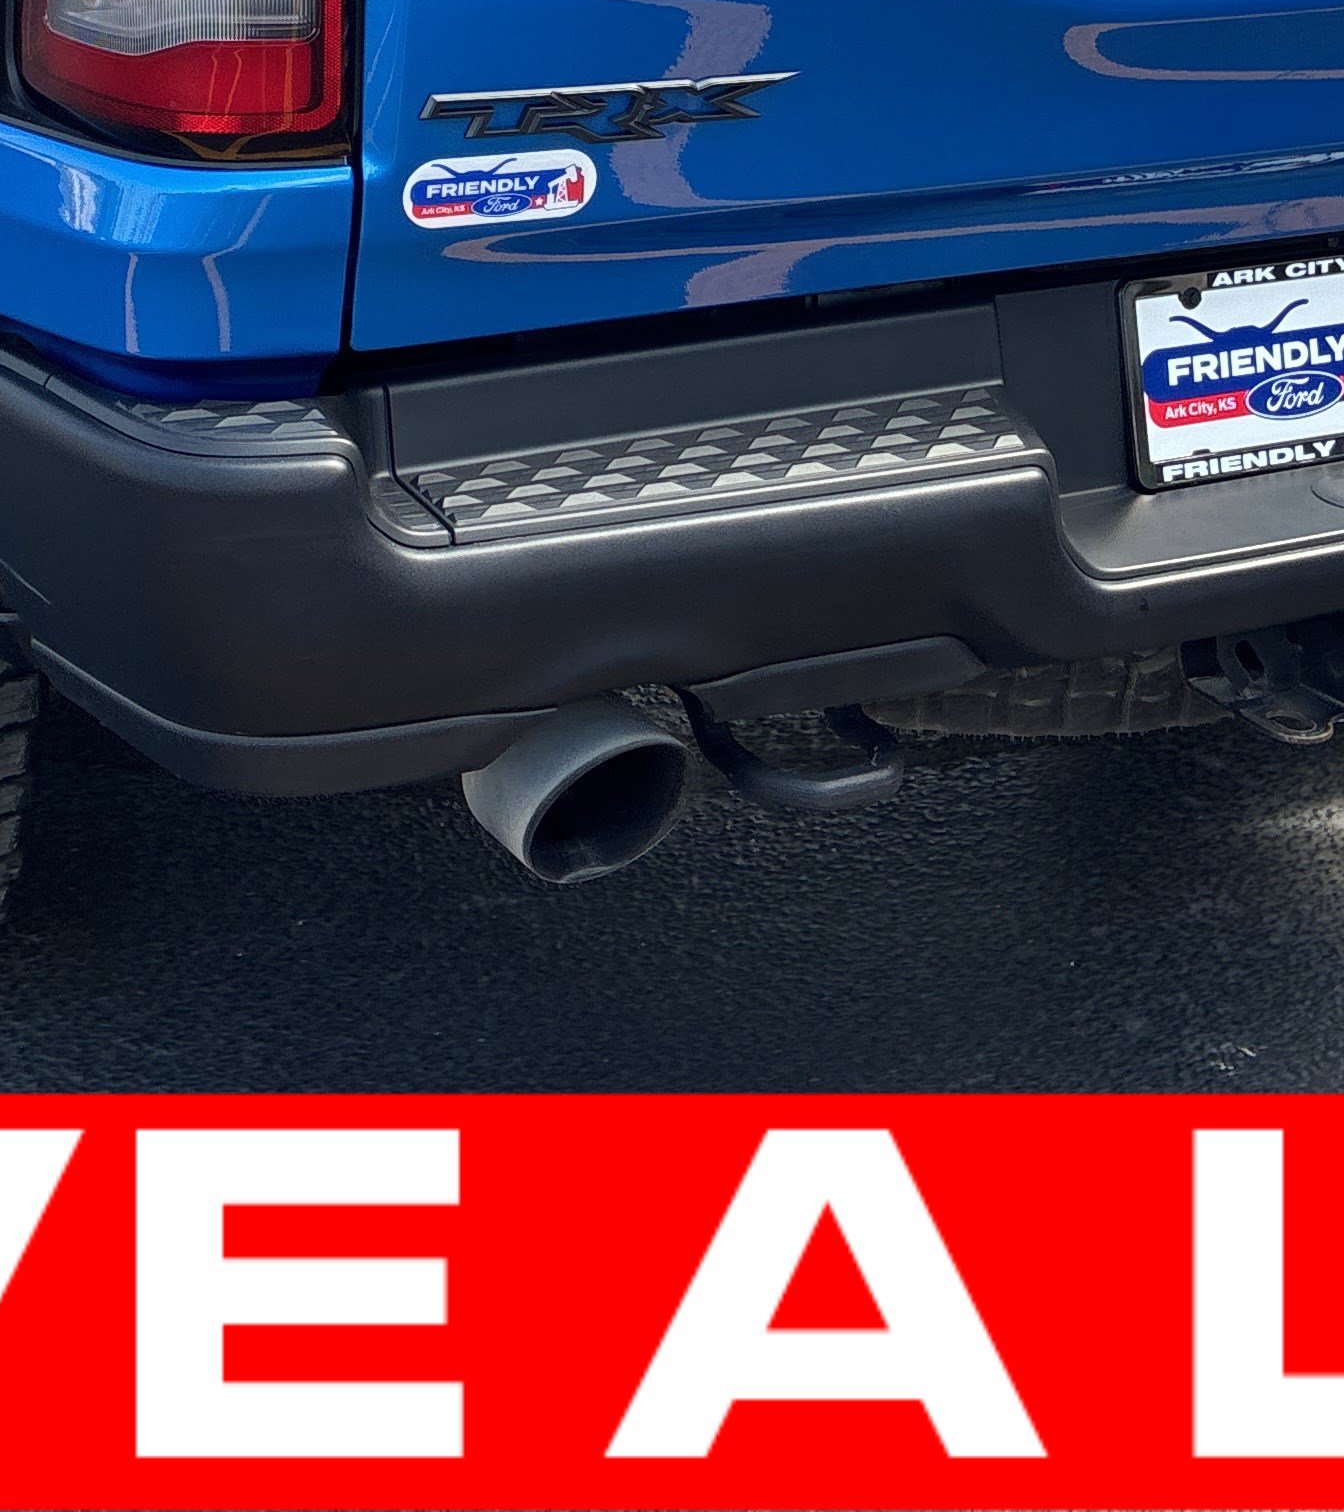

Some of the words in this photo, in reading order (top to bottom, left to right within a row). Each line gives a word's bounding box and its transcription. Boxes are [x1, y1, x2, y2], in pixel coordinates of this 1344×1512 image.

[418, 70, 803, 145] TRX
[425, 175, 541, 199] FRIENDLY
[420, 208, 436, 216] Ark
[482, 195, 521, 214] Ford
[1211, 265, 1276, 288] ARK
[1265, 375, 1325, 412] Ford
[1164, 401, 1188, 420] Ark
[1188, 397, 1217, 418] City,
[1217, 395, 1237, 413] KS
[1161, 438, 1338, 484] FRIENDLY
